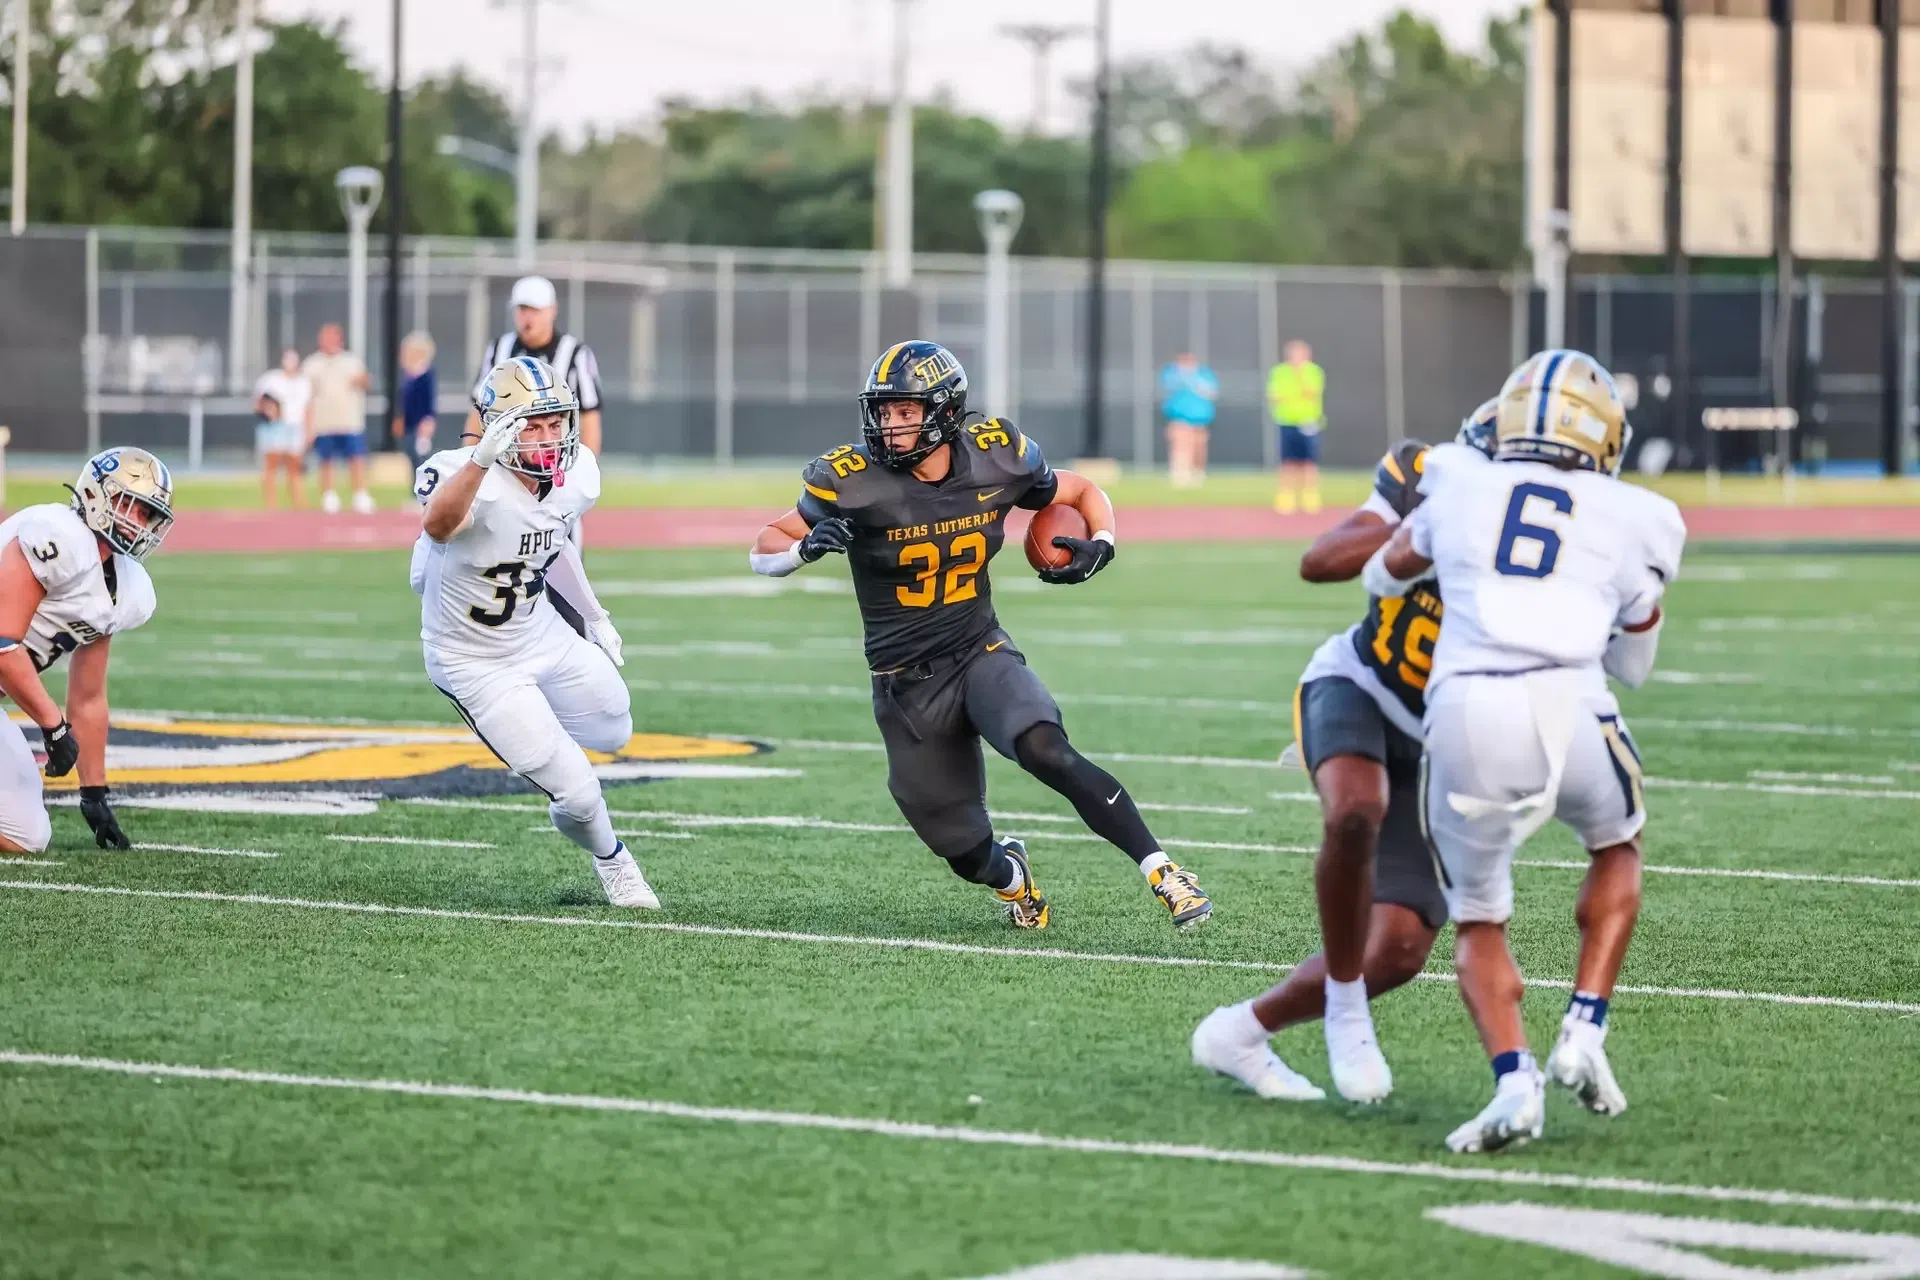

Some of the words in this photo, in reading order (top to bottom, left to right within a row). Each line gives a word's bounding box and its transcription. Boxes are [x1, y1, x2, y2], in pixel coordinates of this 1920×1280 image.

[967, 417, 1009, 450] 32
[820, 444, 868, 478] 32
[518, 528, 555, 556] HPU
[887, 524, 928, 542] TEXAS
[934, 509, 999, 535] LUTHERAN
[1494, 481, 1574, 579] 6
[32, 540, 59, 563] 3
[896, 531, 987, 608] 32
